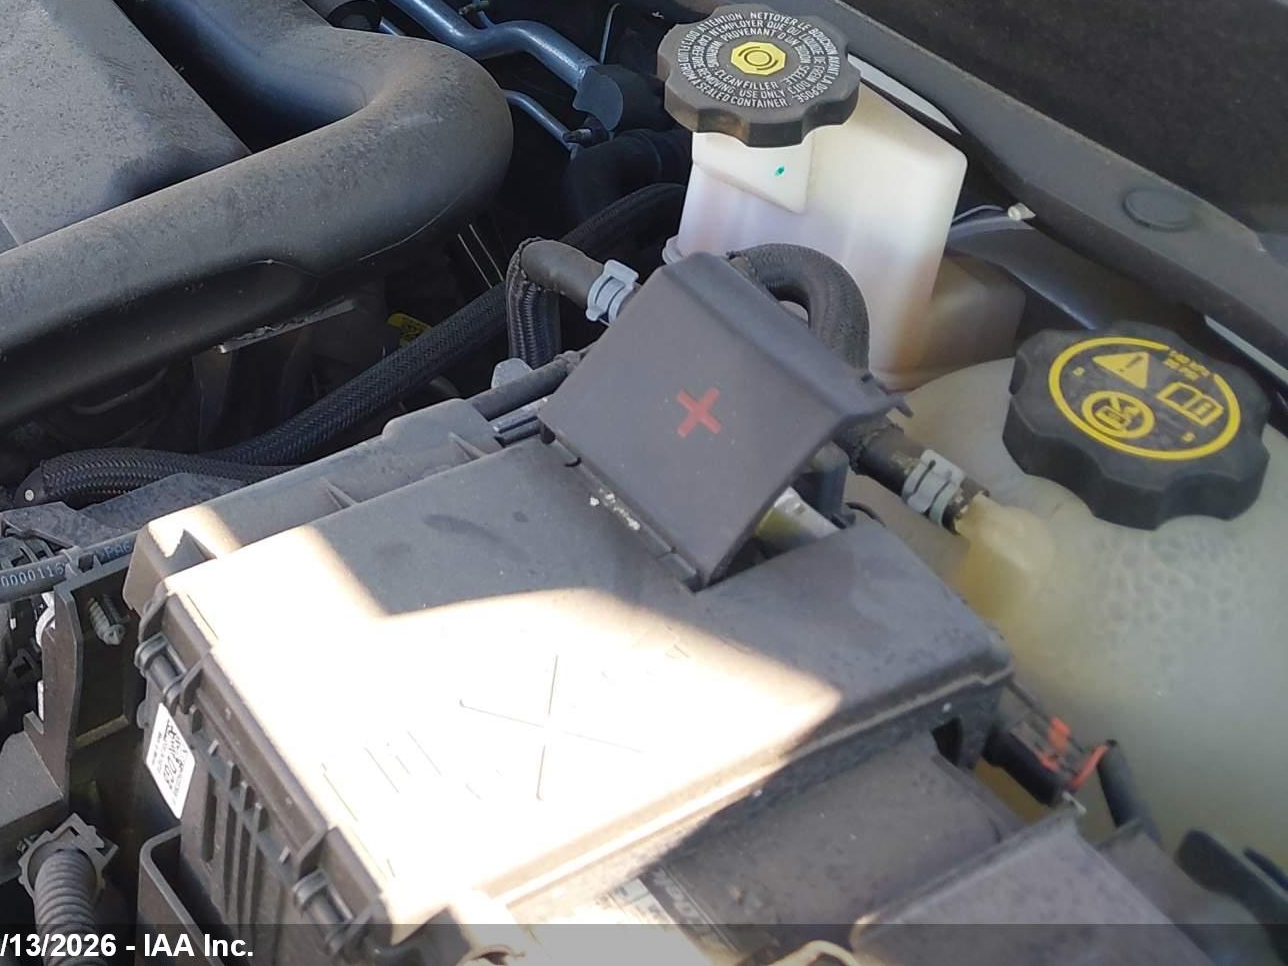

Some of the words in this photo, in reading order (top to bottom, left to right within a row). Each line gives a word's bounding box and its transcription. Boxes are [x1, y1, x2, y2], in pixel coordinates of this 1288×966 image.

[750, 11, 798, 26] NETTOYER
[767, 20, 787, 31] QUE
[797, 21, 812, 31] LE
[720, 27, 776, 42] PROVENANT
[787, 26, 802, 36] DU
[697, 34, 713, 47] CAP
[799, 33, 825, 55] LIQUIDE
[808, 27, 839, 55] BOUCHON
[678, 45, 692, 63] FLUID
[692, 45, 706, 69] BEFORE
[814, 55, 826, 65] DE
[679, 62, 698, 81] FROM
[827, 55, 841, 76] AVANT
[715, 69, 743, 87] CLEAN
[743, 80, 779, 91] FILLER
[806, 64, 825, 84] FREIN
[821, 74, 836, 85] LA
[696, 81, 731, 102] SEALED
[739, 89, 758, 99] USE
[760, 89, 786, 99] ONLY
[788, 80, 811, 95] DOT3
